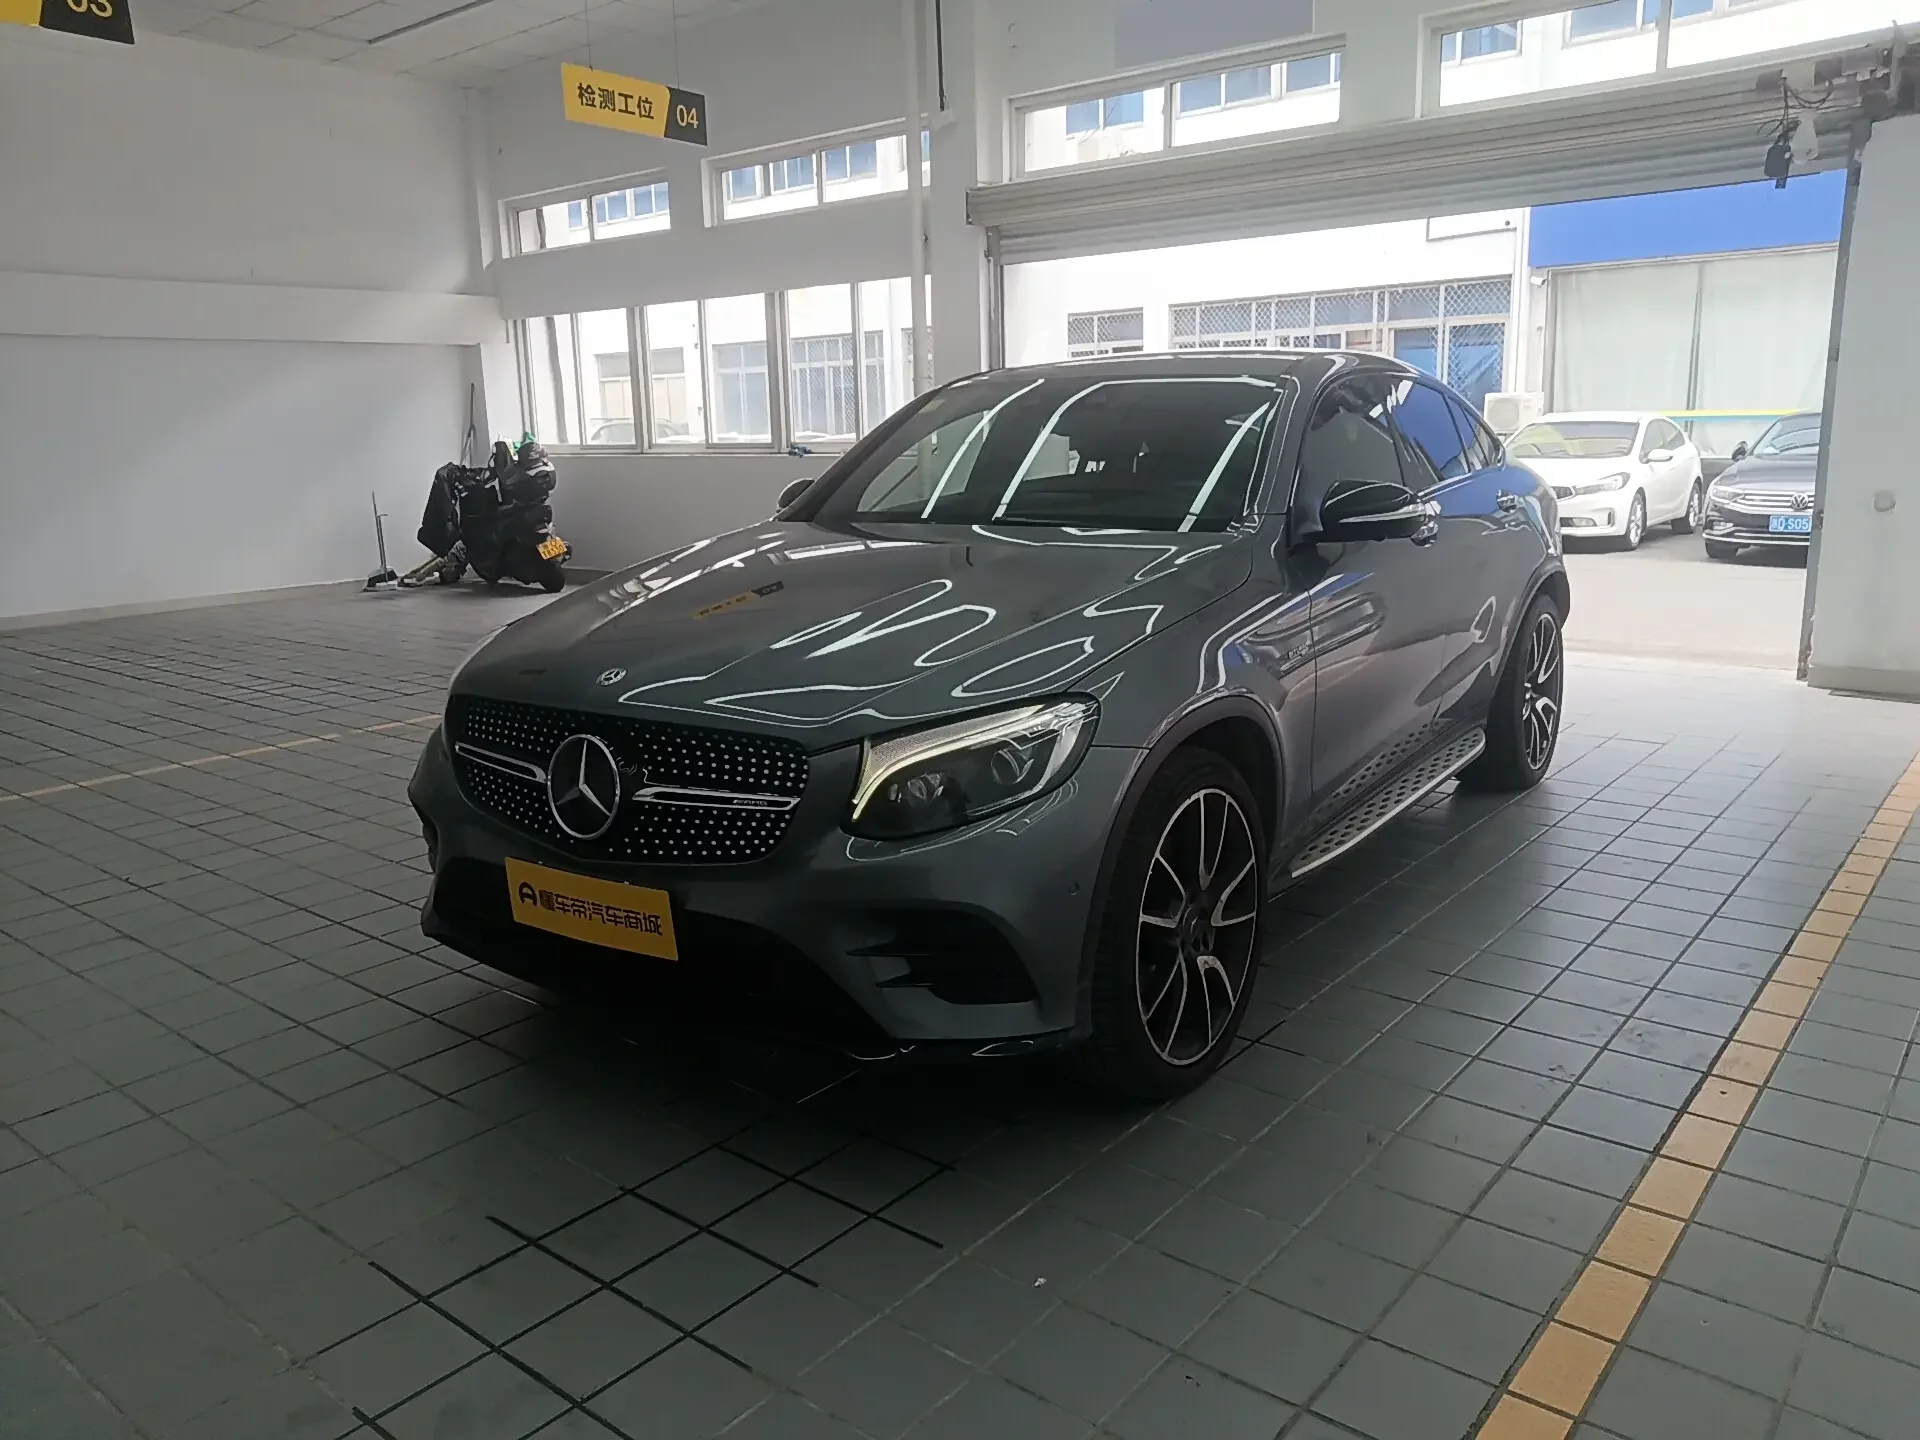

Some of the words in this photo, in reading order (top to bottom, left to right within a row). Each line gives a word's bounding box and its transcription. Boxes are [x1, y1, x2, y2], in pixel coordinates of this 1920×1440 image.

[577, 82, 654, 120] 检测工位
[676, 104, 699, 129] 04
